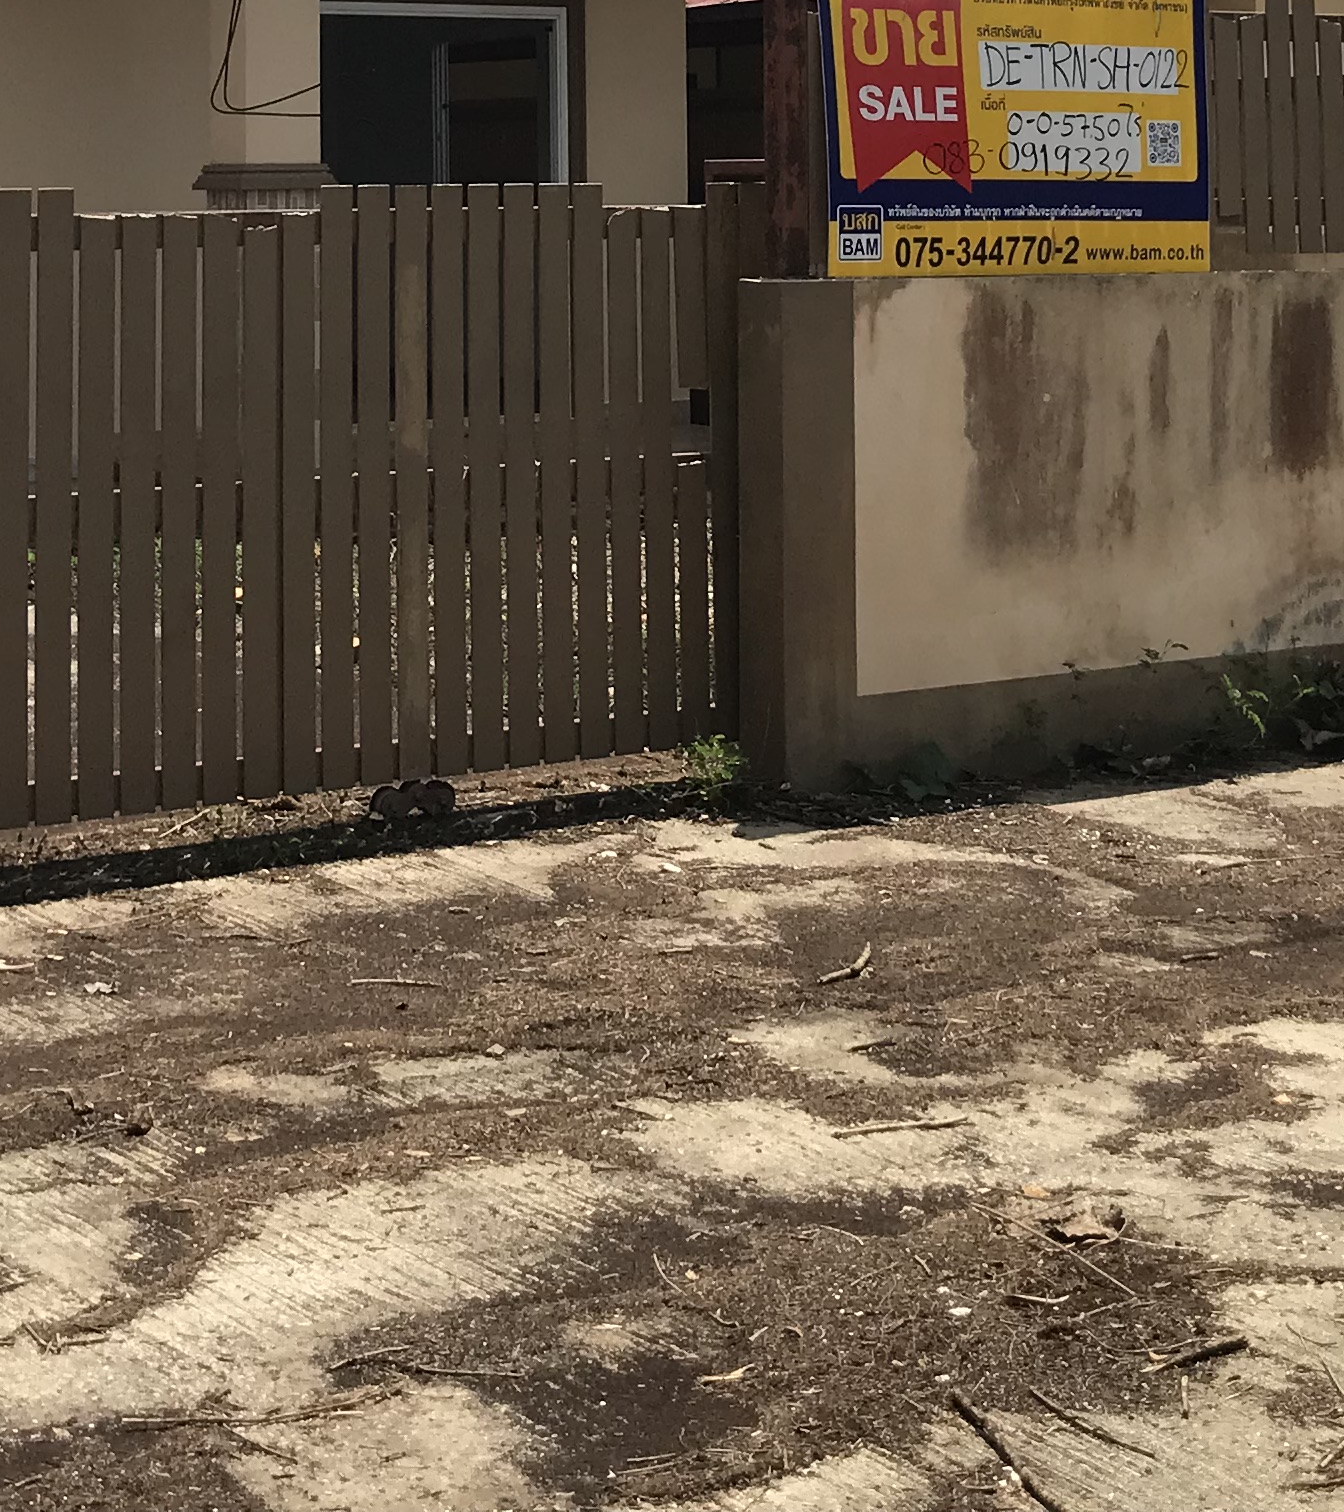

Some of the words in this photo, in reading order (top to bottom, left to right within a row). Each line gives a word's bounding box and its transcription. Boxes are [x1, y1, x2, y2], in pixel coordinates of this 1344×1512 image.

[849, 6, 958, 67] ขาย
[976, 23, 1042, 39] รหัสทรัพย์สิน
[984, 41, 1191, 90] DE-TRN-SH-0122
[858, 84, 958, 122] SALE
[981, 92, 1006, 110] เนื้อที่
[842, 211, 879, 231] บสก
[842, 237, 879, 256] BAM
[894, 235, 1079, 268] 075-344770-2
[1085, 241, 1205, 261] www.bam.co.th
